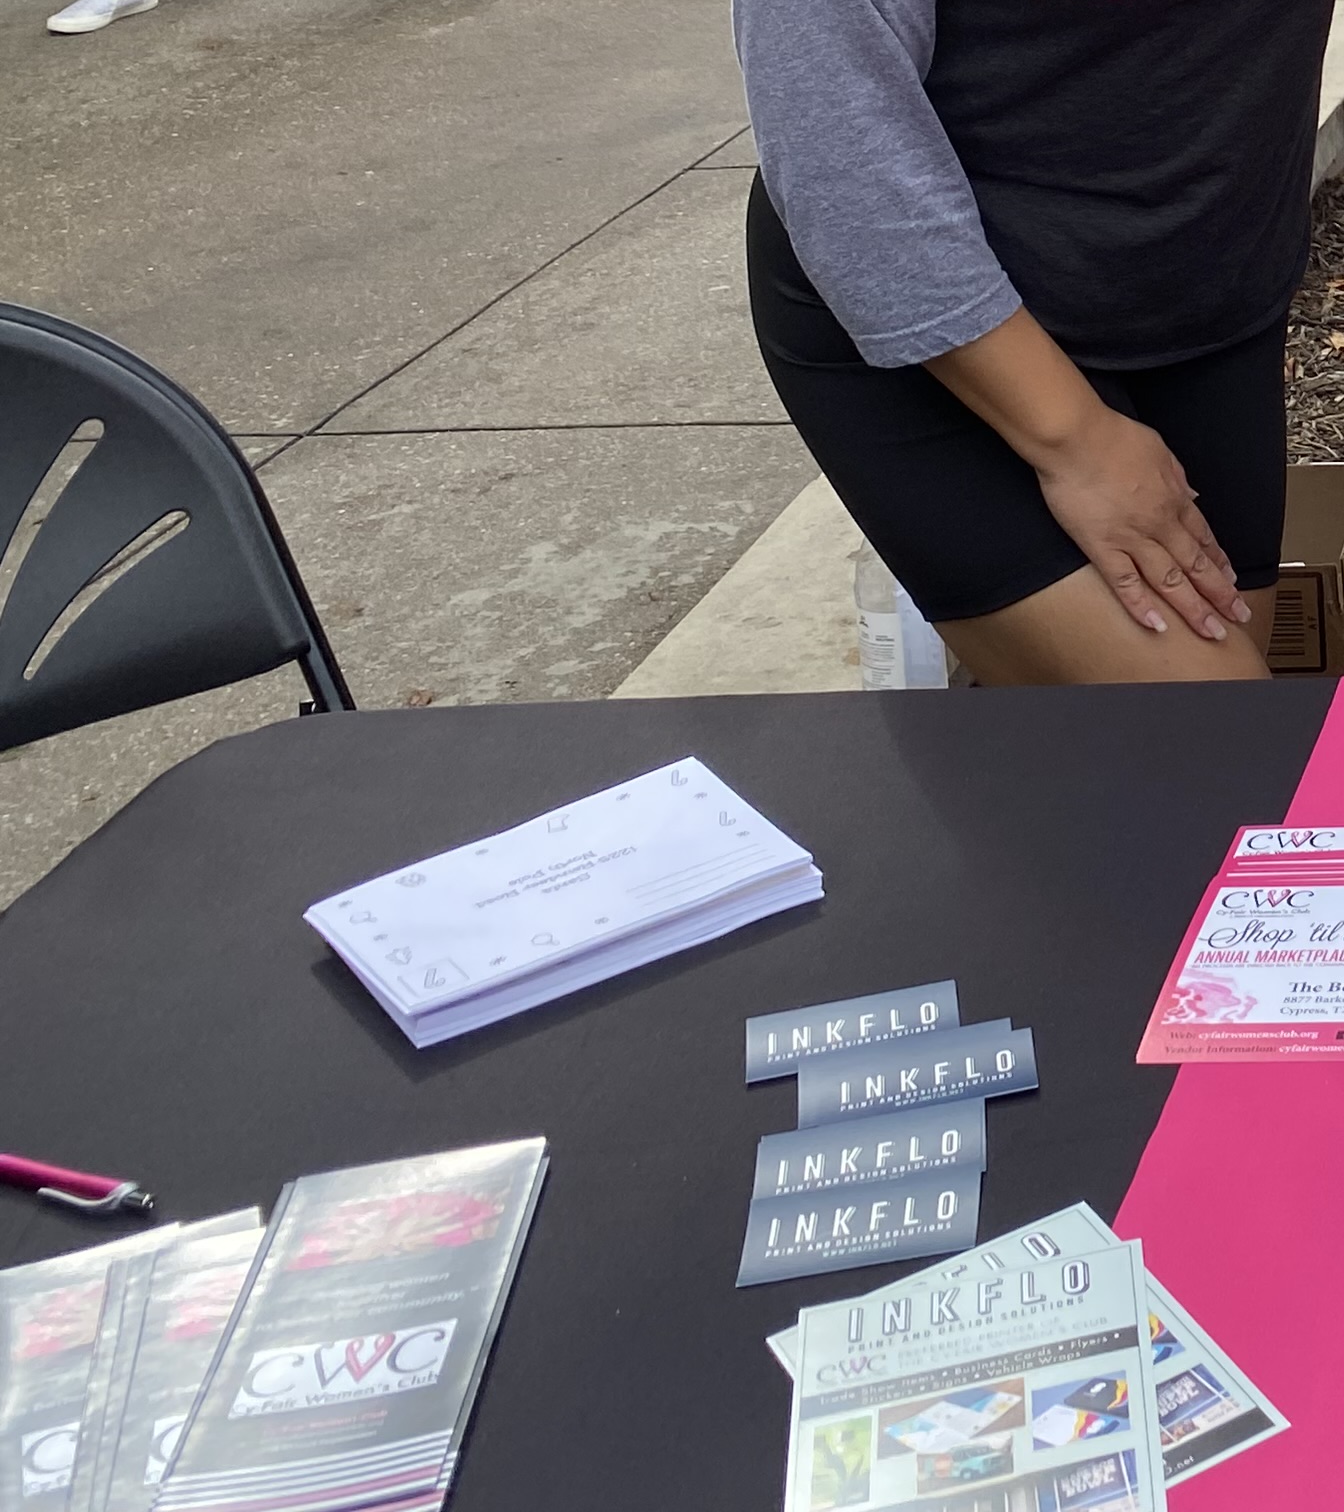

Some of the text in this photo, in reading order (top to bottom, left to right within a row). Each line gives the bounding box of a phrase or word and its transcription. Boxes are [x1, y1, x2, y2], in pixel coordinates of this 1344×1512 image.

[1246, 830, 1336, 850] CWC
[1221, 889, 1315, 909] CWC
[1199, 919, 1297, 950] Shop
[1193, 951, 1251, 964] ANNUAL
[1283, 996, 1313, 1004] 8877
[1289, 982, 1323, 993] The
[1279, 1007, 1329, 1016] Cypress,
[767, 1001, 939, 1055] INKFLO
[840, 1049, 1015, 1104] INKFLO
[777, 1129, 962, 1186] INKFLO
[768, 1191, 958, 1247] INKFLO
[848, 1260, 1090, 1343] INKFLO
[242, 1328, 445, 1398] CWC
[816, 1353, 888, 1386] CWC
